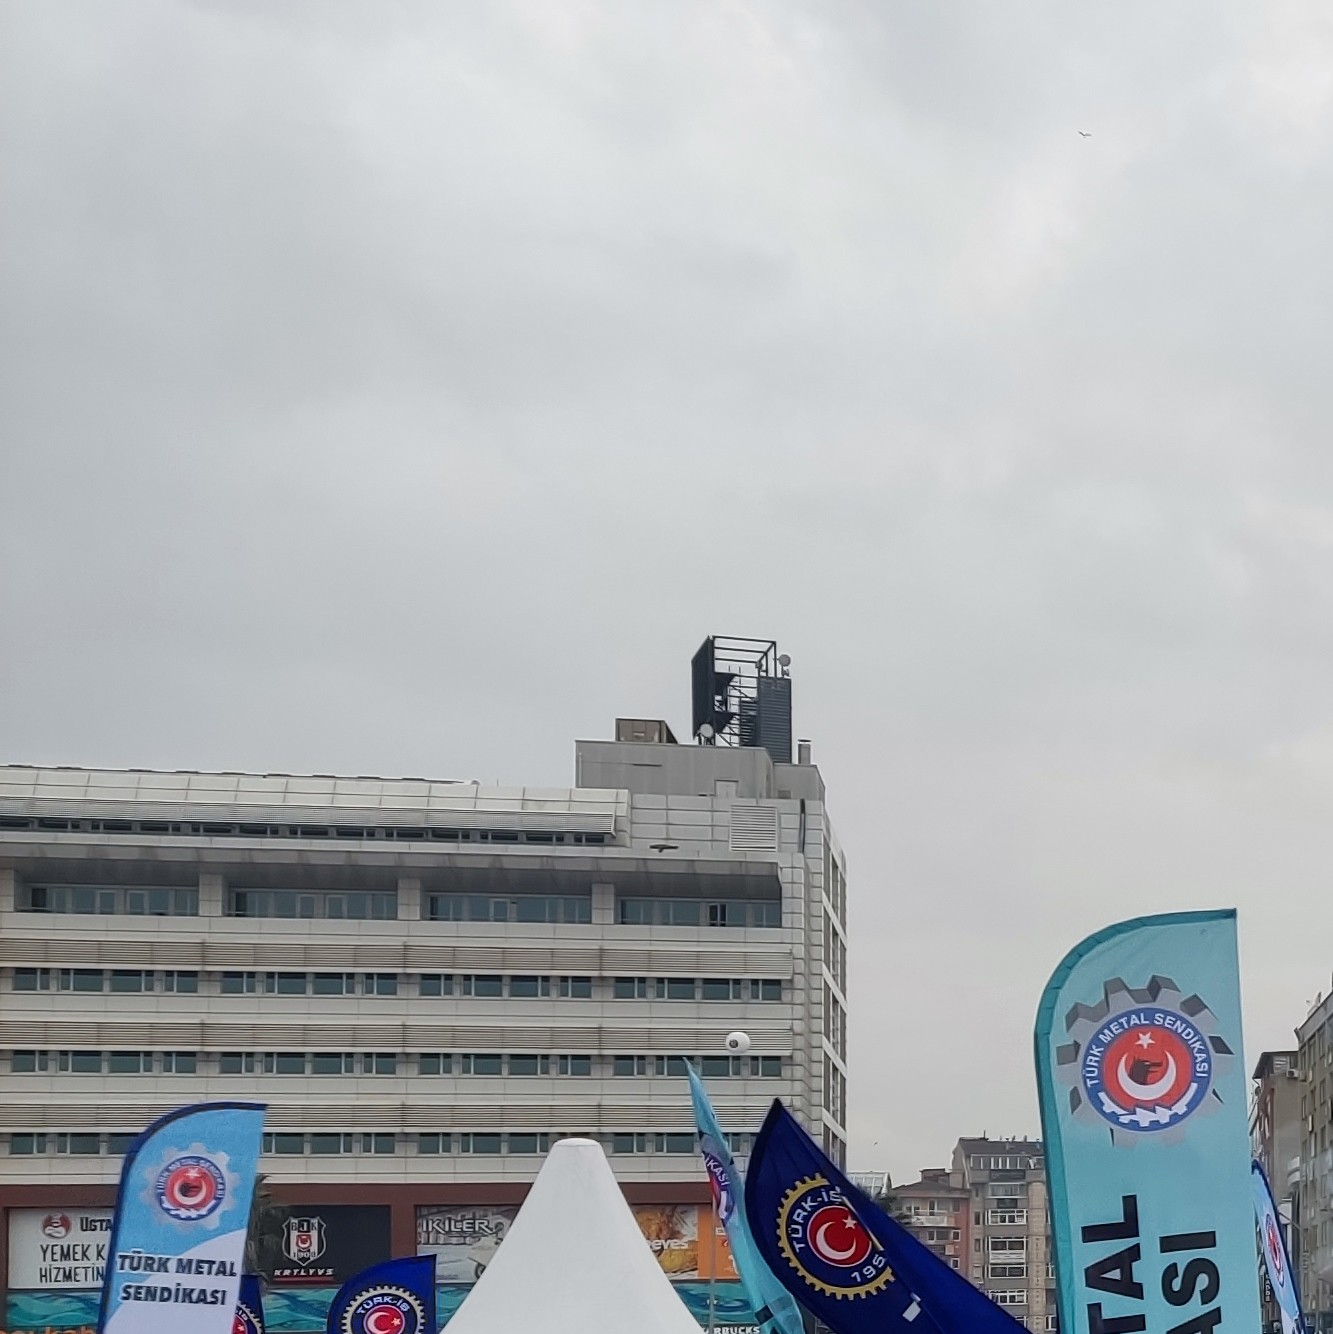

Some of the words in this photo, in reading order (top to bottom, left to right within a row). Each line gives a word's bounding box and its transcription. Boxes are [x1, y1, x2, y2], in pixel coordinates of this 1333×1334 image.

[1083, 1044, 1104, 1088] TÜRK
[1098, 1012, 1149, 1044] METAL
[1153, 1012, 1209, 1078] SENDİKASI
[788, 1185, 843, 1254] TÜRK-İŞ
[40, 1244, 91, 1263] YEMEK
[117, 1249, 171, 1275] TÜRK
[175, 1259, 237, 1278] METAL
[120, 1282, 227, 1306] SENDİKASI
